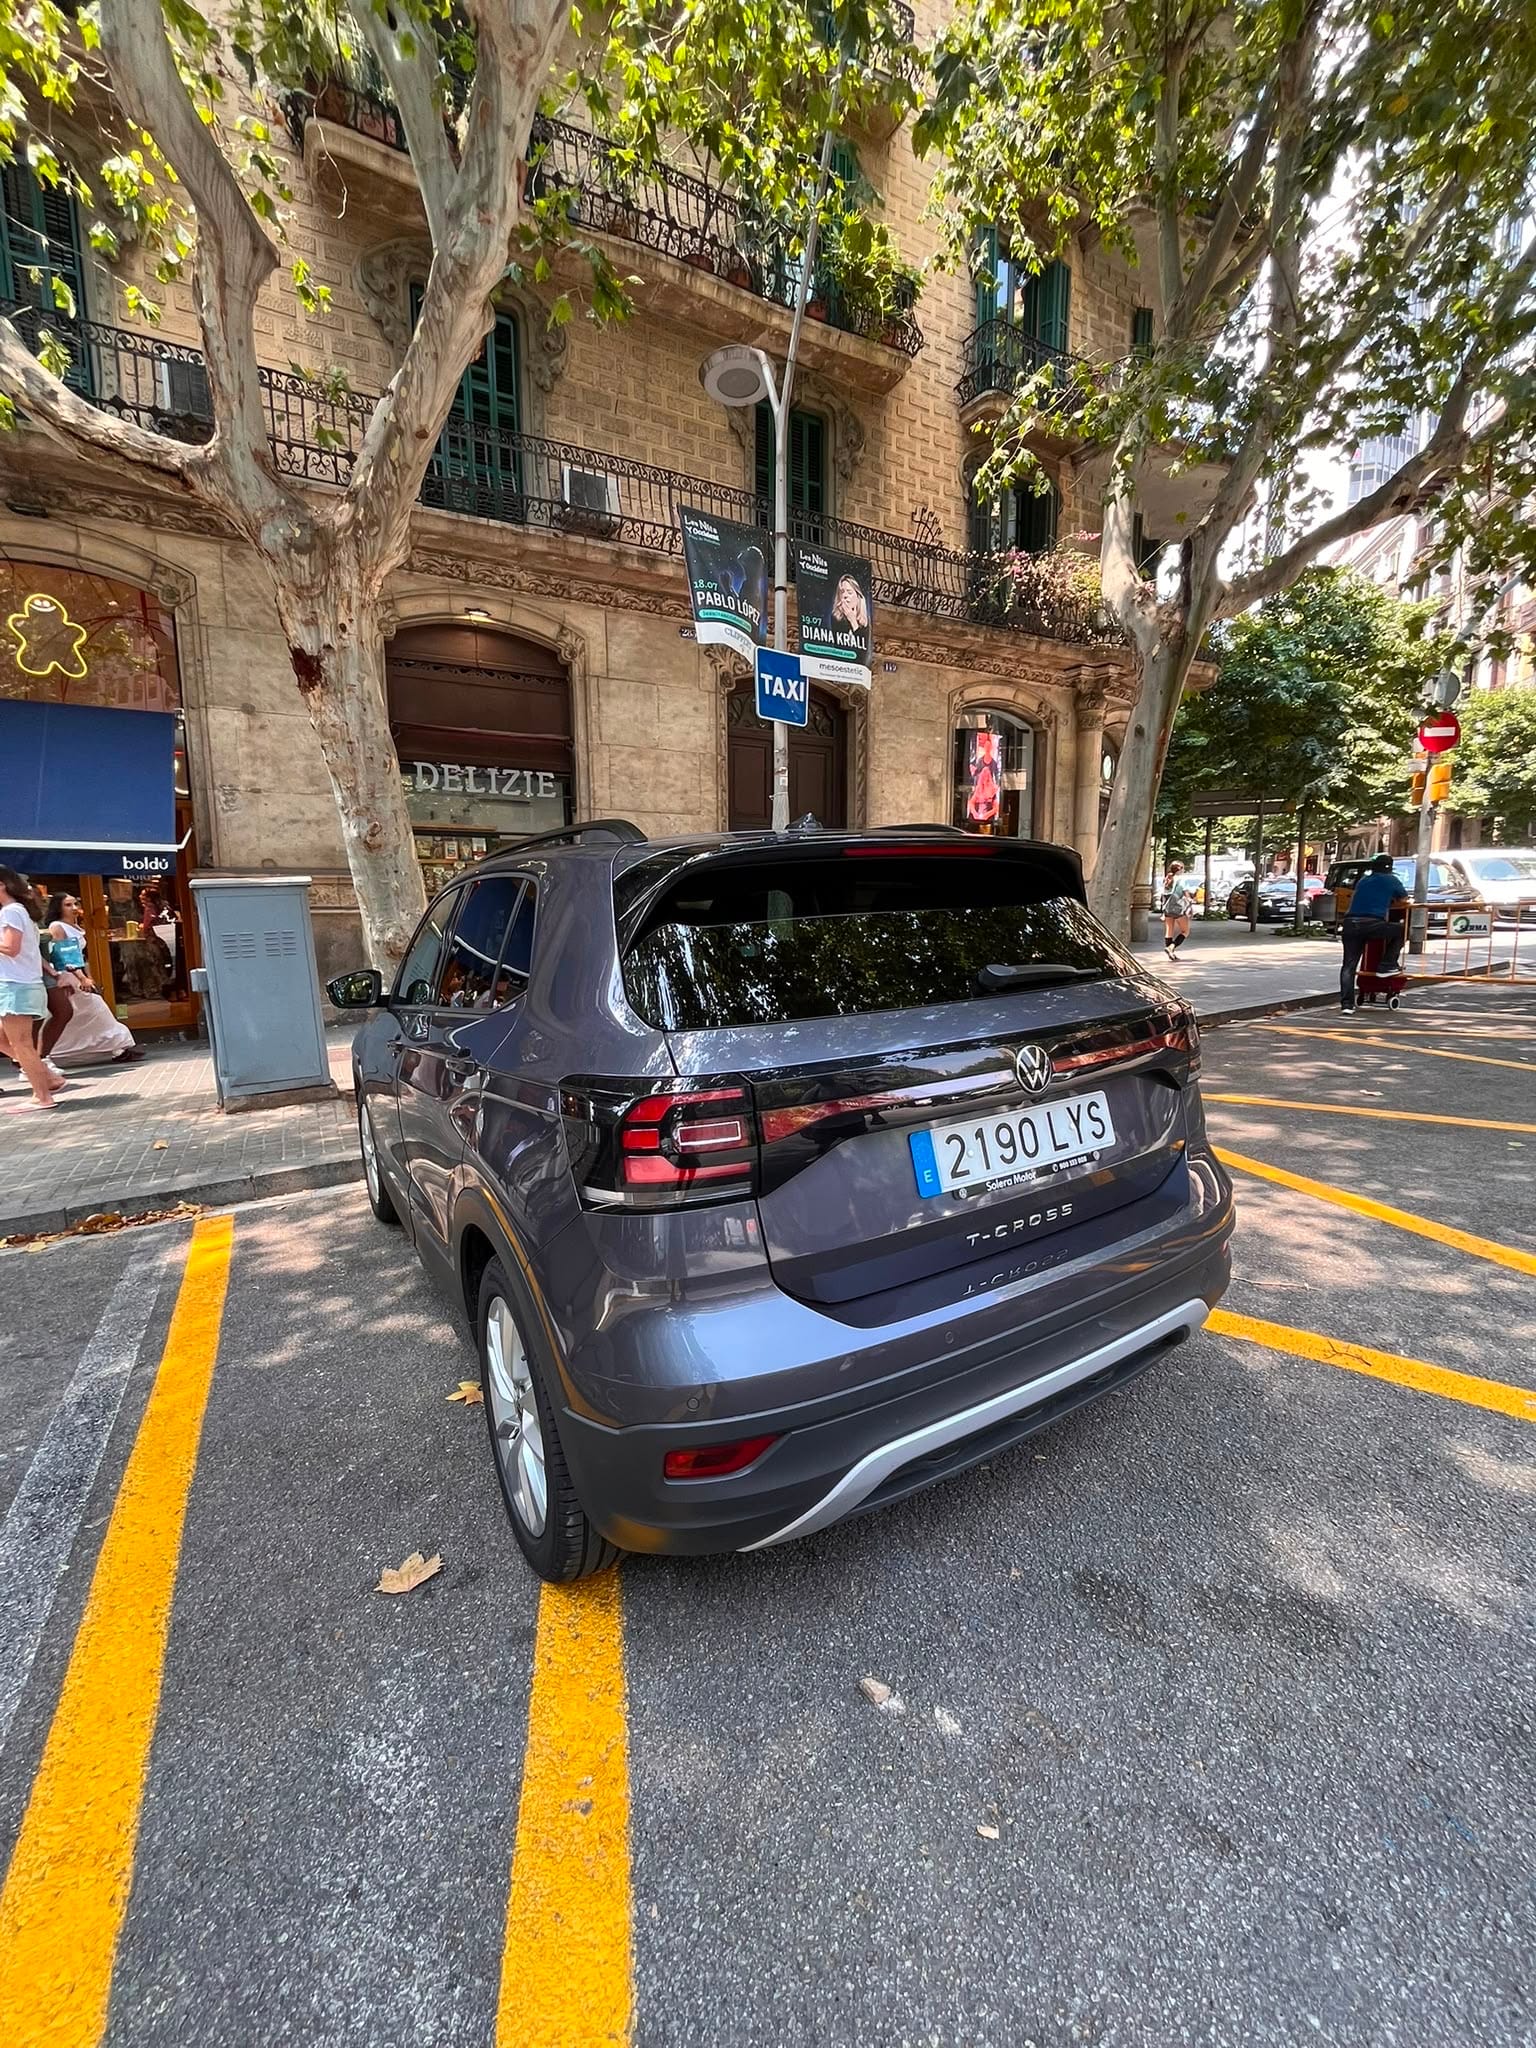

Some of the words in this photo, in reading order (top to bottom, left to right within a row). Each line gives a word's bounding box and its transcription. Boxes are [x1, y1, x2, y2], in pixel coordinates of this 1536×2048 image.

[693, 579, 718, 591] 18.07
[696, 591, 735, 610] PABLO
[737, 599, 760, 626] LÓPEZ
[801, 615, 822, 626] 19.07
[802, 625, 835, 644] DIANA
[836, 631, 867, 651] KRALL
[819, 663, 863, 676] mesoestetic
[760, 673, 805, 702] TAXI
[413, 761, 557, 798] DELIZIE
[122, 856, 169, 870] boldú
[945, 1116, 1040, 1180] 2190
[1046, 1101, 1106, 1152] LYS
[923, 1169, 934, 1184] E
[985, 1175, 1013, 1192] Solera
[1013, 1170, 1037, 1185] Motor
[966, 1203, 1073, 1247] T-CROSS
